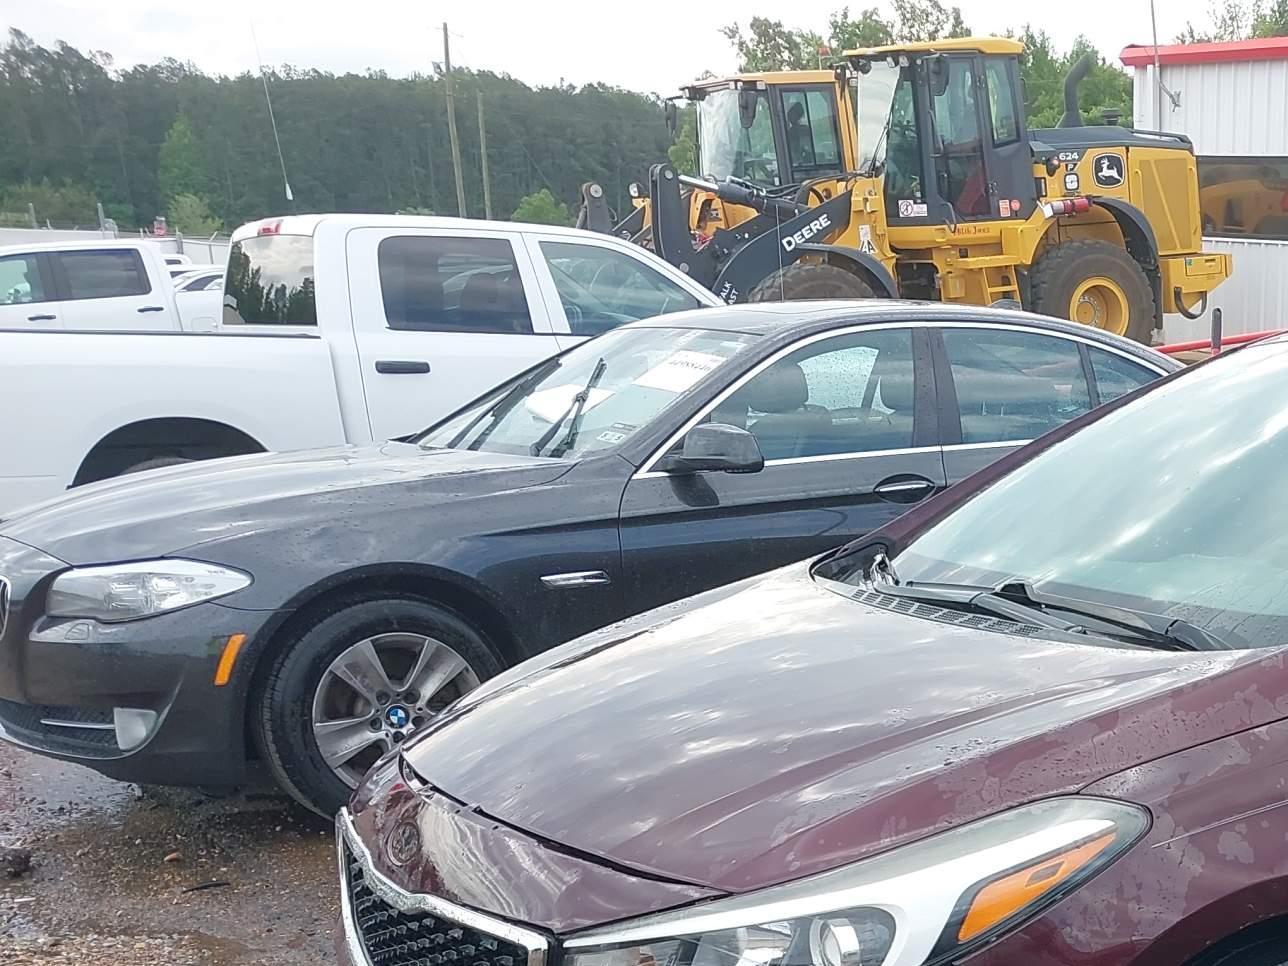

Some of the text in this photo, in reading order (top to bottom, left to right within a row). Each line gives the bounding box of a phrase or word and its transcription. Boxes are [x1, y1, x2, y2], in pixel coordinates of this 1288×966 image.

[1058, 152, 1079, 160] 624
[781, 213, 831, 252] DEERE
[719, 281, 733, 299] ALK
